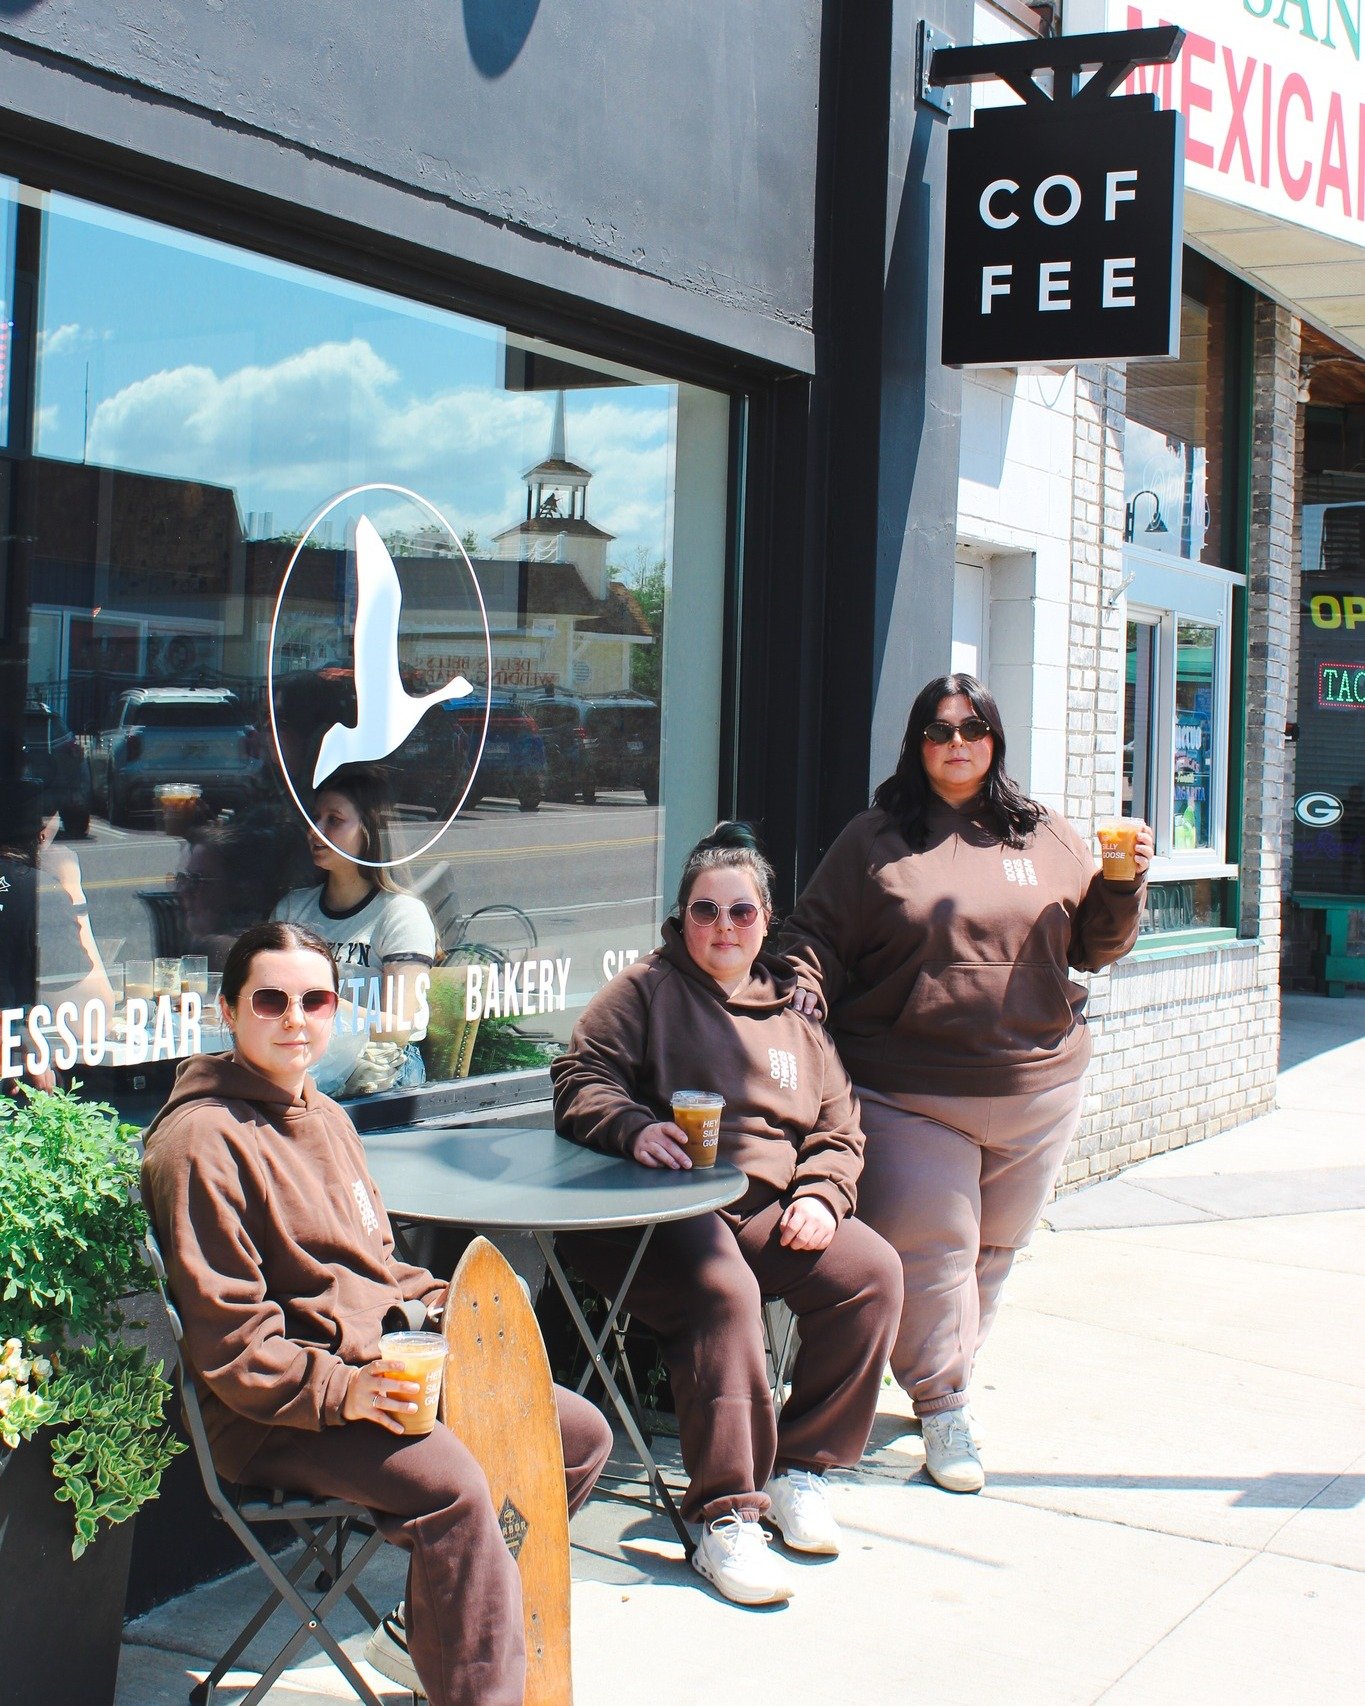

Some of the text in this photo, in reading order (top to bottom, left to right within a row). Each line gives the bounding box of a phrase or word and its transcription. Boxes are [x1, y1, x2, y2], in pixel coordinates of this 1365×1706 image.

[1244, 0, 1362, 61] AN
[1126, 5, 1365, 222] MEXICA
[979, 170, 1138, 230] COF
[981, 257, 1136, 314] FEE
[125, 991, 202, 1066] BAR
[466, 957, 571, 1021] BAKERY
